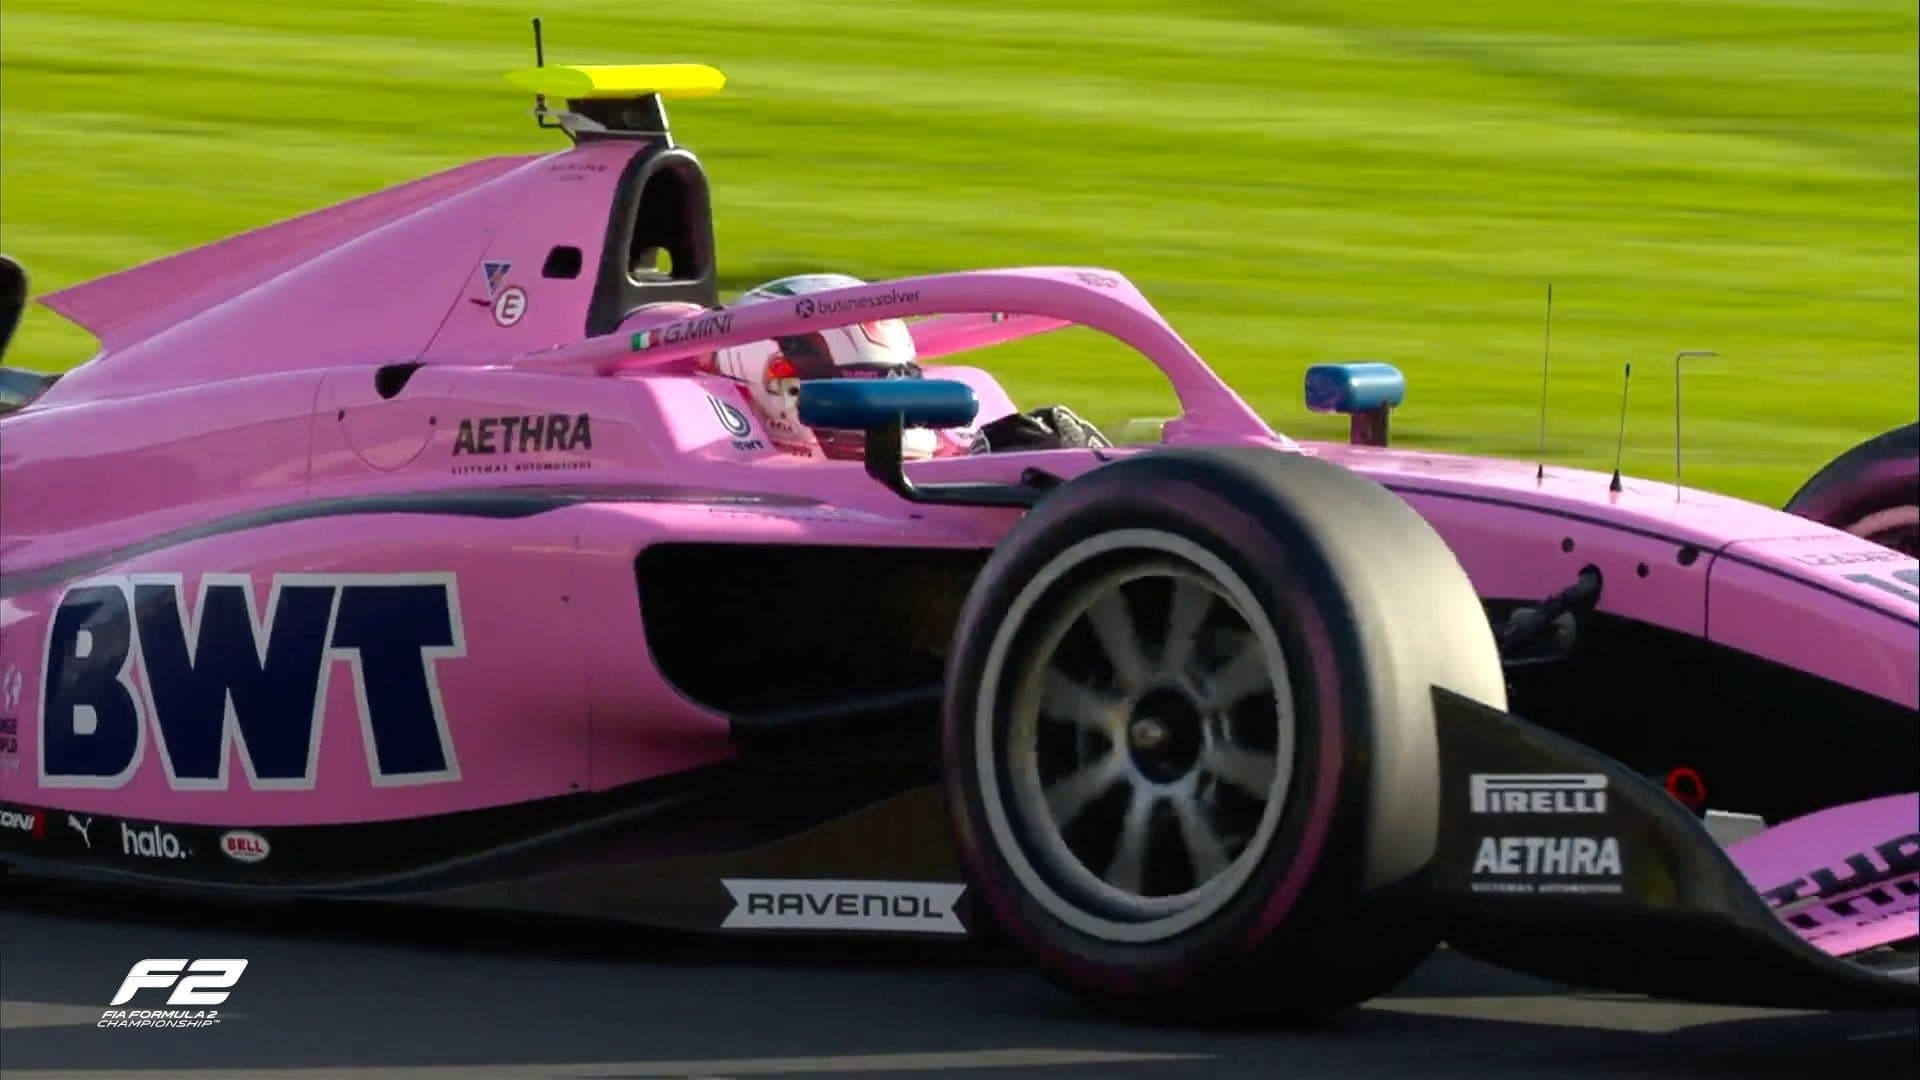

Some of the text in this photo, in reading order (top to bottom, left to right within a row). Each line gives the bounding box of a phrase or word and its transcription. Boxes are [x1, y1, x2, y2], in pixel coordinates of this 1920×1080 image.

[502, 294, 520, 318] E
[664, 311, 732, 342] G.MINI
[452, 413, 592, 456] AETHRA
[38, 572, 467, 790] BWT
[1470, 773, 1608, 813] PIRELLI
[227, 838, 264, 853] BELL
[1472, 836, 1622, 875] AETHRA
[748, 893, 943, 918] RAVENOL
